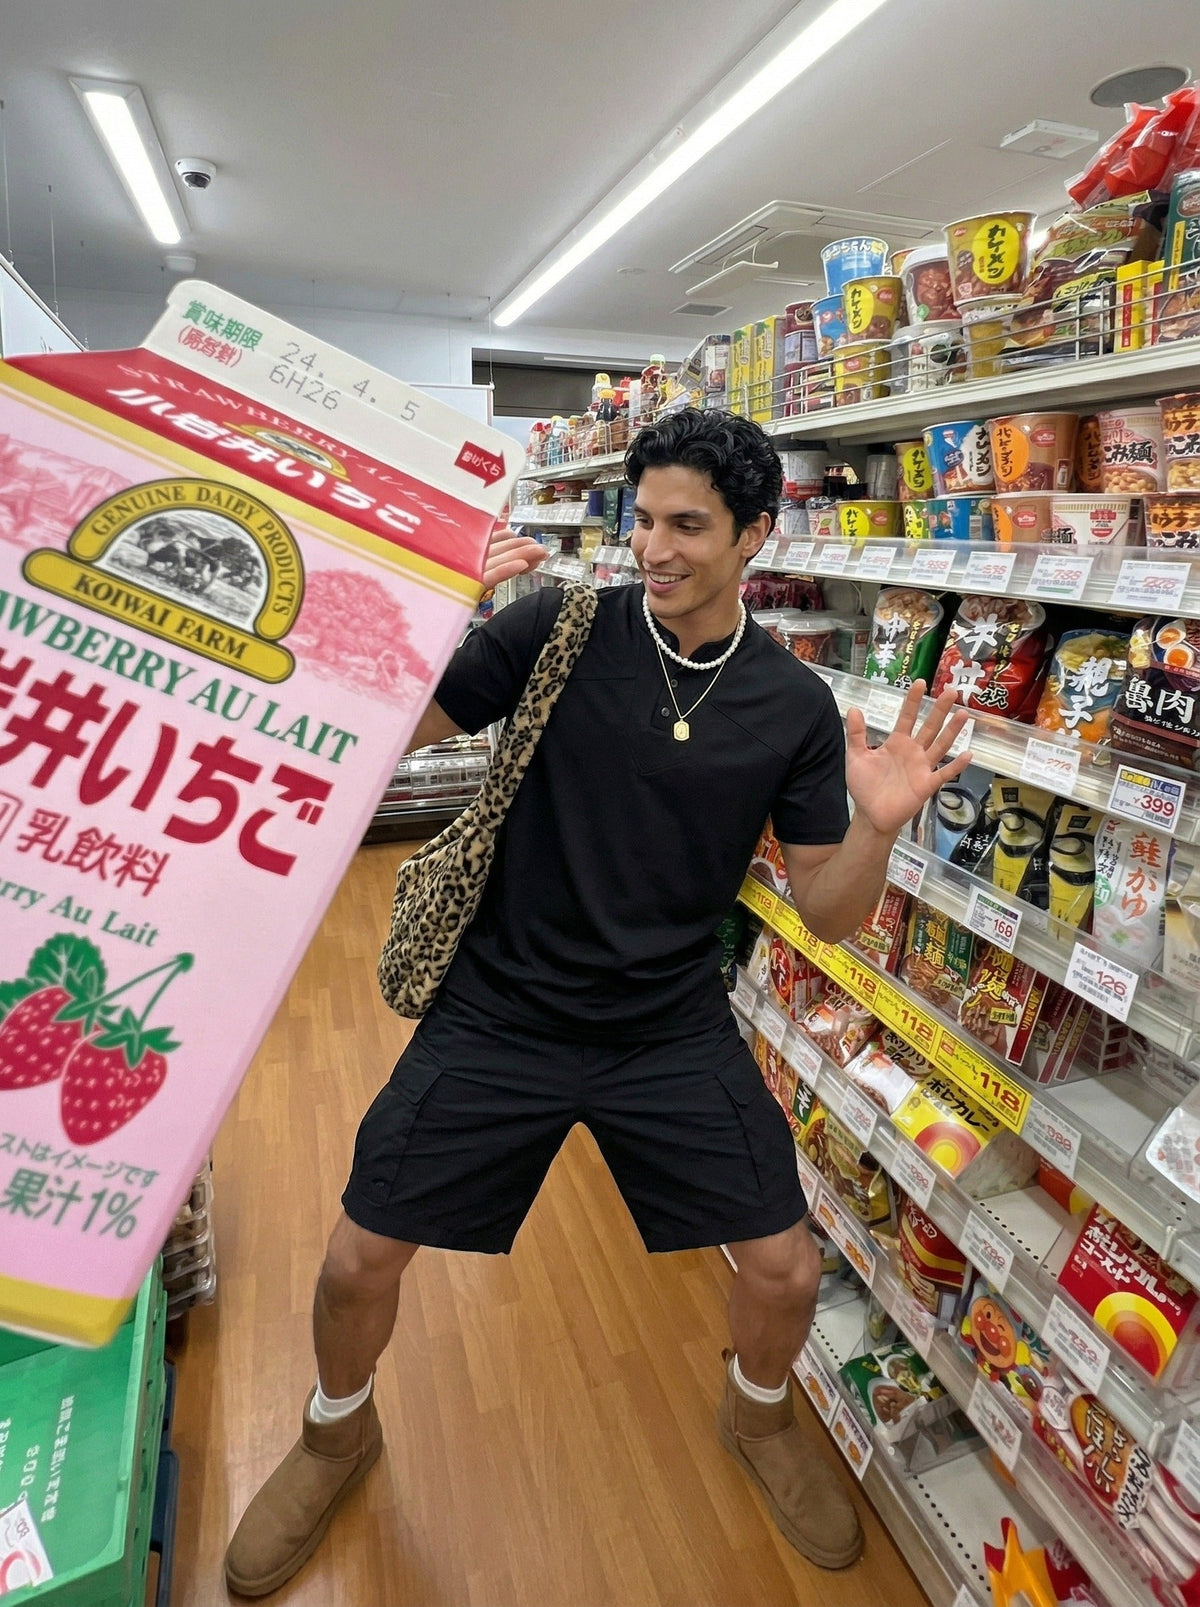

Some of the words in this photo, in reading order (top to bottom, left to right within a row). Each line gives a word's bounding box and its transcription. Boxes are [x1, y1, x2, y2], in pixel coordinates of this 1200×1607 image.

[269, 363, 342, 411] 6H26
[400, 400, 420, 422] 5
[91, 485, 186, 537] GENUINE
[257, 520, 297, 616] PRODUCTS
[73, 572, 172, 627] KOIWAI
[176, 612, 249, 660] FARM
[188, 678, 256, 722] AU
[253, 700, 359, 765] LAIT
[16, 808, 171, 897] 乳飲料
[0, 877, 47, 910] rry
[48, 895, 93, 925] Au
[101, 910, 161, 947] Lait
[993, 918, 1014, 939] 168
[797, 925, 819, 948] 118
[850, 967, 878, 995] 118
[1096, 969, 1129, 997] 126
[901, 1009, 934, 1042] 118
[980, 1071, 1021, 1113] 118
[0, 1167, 144, 1239] 果汁1%
